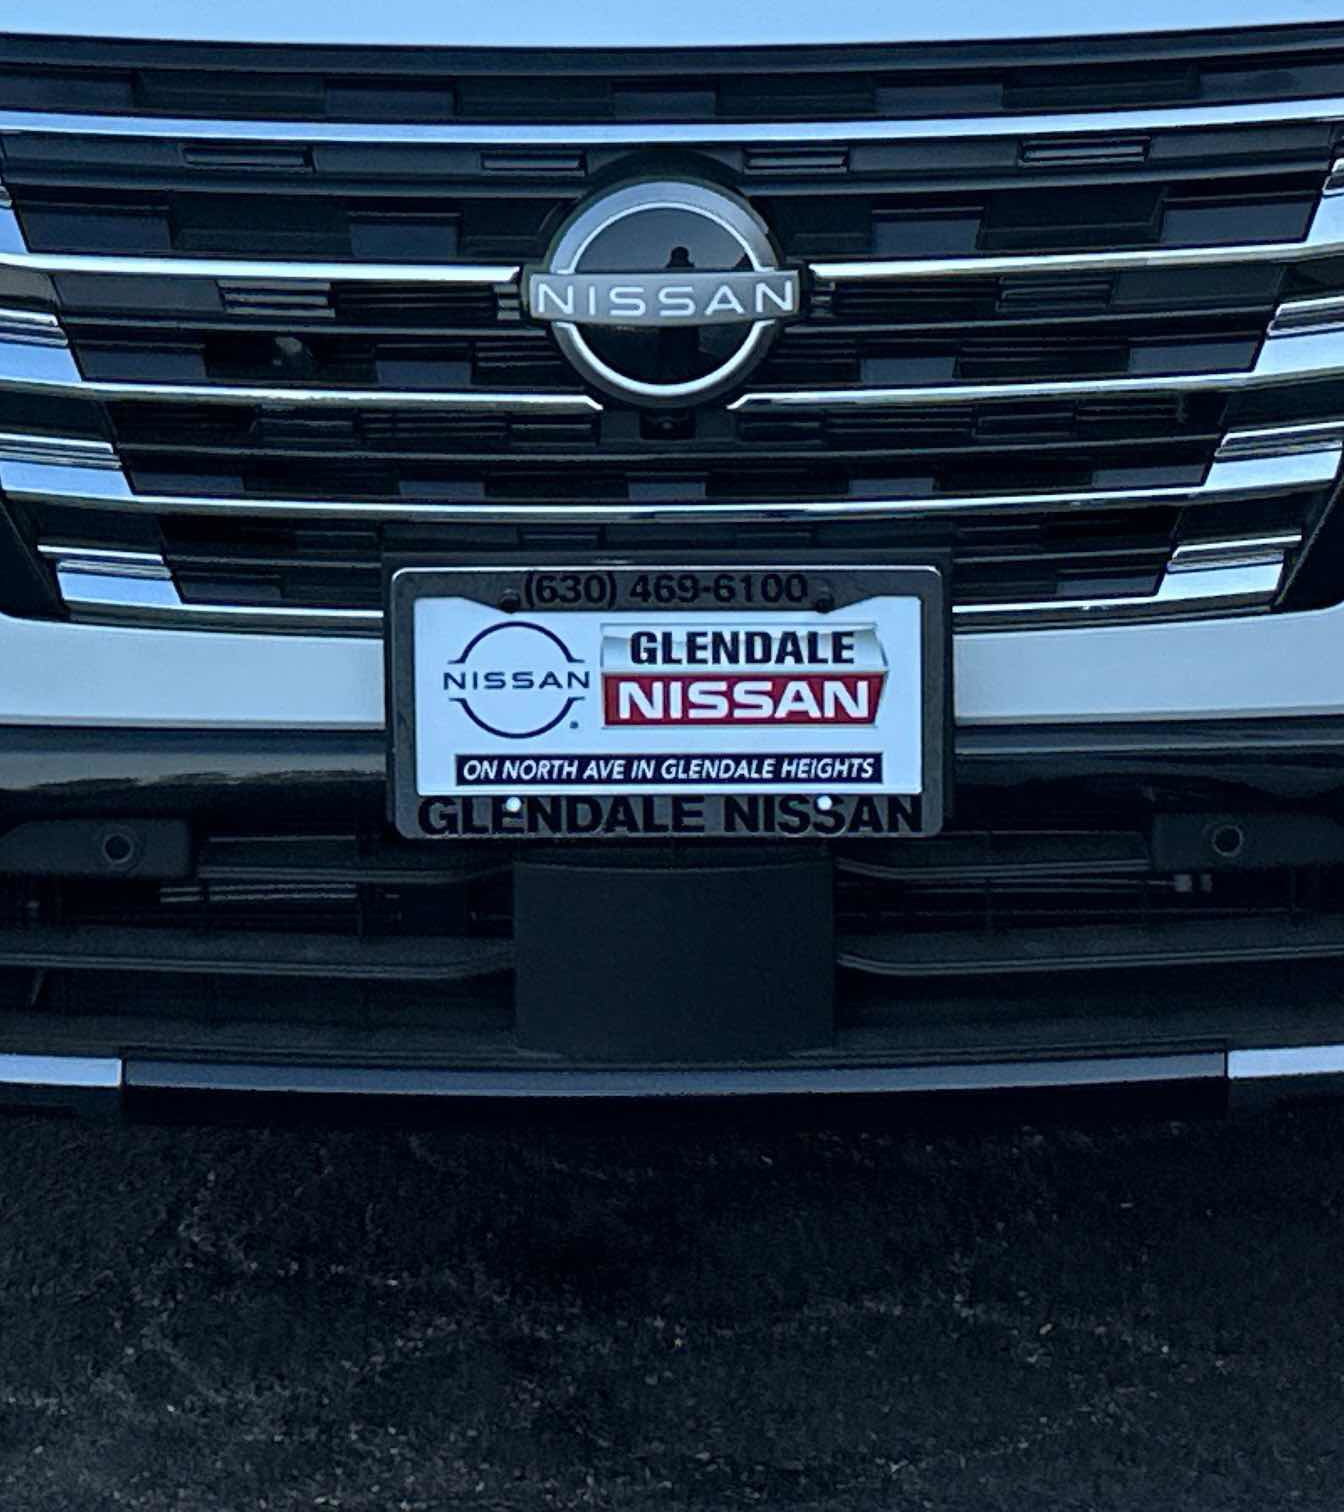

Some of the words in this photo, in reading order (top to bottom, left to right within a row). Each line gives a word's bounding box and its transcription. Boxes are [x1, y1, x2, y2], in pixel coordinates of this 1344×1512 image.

[536, 281, 794, 317] NISSAN
[524, 570, 617, 609] (630)
[629, 573, 808, 604] 469-6100
[629, 630, 856, 666] GLENDALE
[443, 670, 590, 690] NISSAN
[618, 680, 869, 720] NISSAN
[462, 759, 500, 781] ON
[502, 759, 577, 780] NORTH
[582, 759, 625, 780] AVE
[630, 759, 658, 779] IN
[660, 759, 775, 779] GLENDALE
[779, 757, 875, 779] HEIGHTS
[416, 794, 706, 836] GLENDALE
[723, 793, 924, 835] NISSAN
